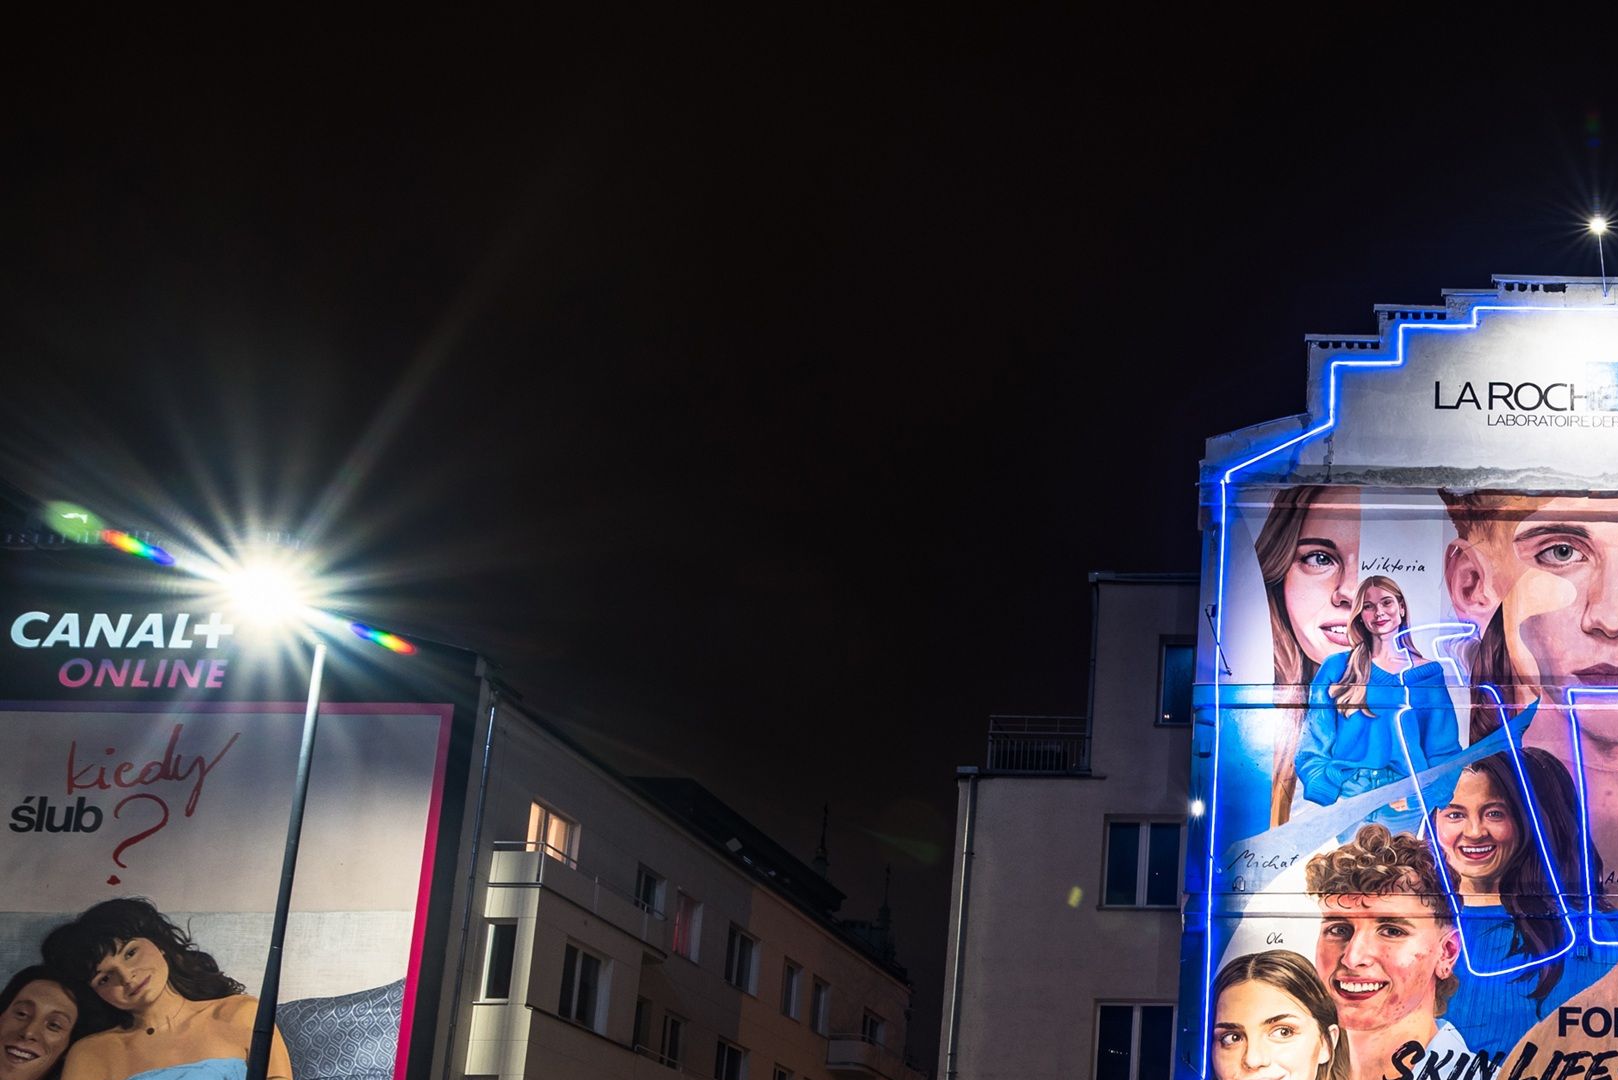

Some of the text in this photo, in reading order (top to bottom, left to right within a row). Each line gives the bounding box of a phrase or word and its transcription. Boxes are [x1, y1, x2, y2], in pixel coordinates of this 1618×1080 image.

[1434, 381, 1481, 410] LA
[1487, 414, 1590, 427] LABORATOIRE
[1361, 557, 1425, 573] Wiktoria
[10, 611, 234, 649] CANAL+
[58, 658, 228, 688] ONLINE
[67, 723, 241, 817] kiedy
[9, 796, 103, 833] ślub
[1266, 932, 1284, 945] Ola
